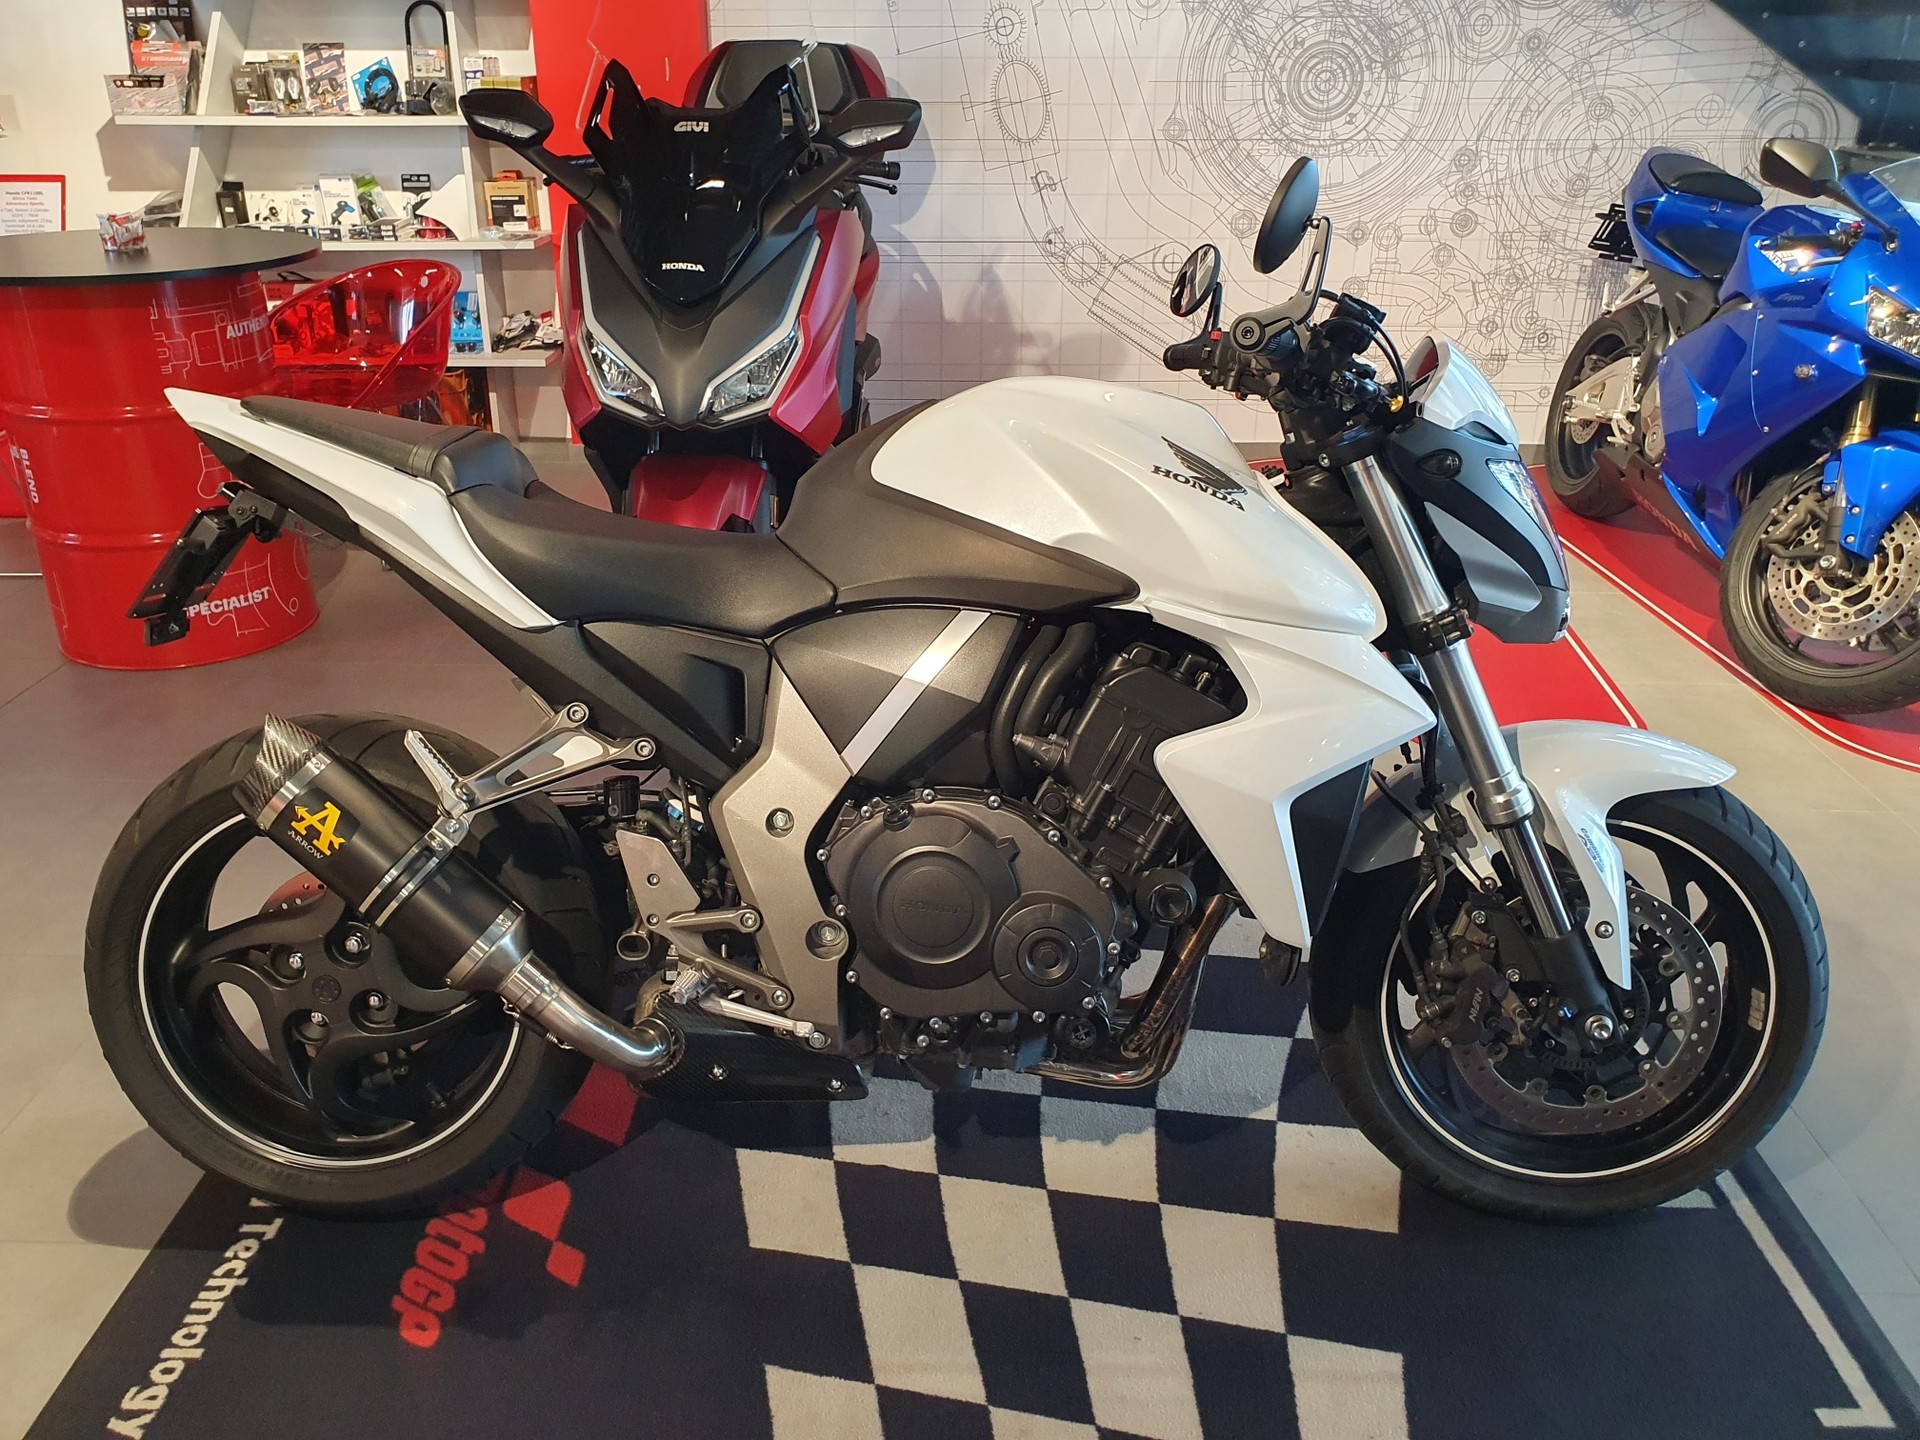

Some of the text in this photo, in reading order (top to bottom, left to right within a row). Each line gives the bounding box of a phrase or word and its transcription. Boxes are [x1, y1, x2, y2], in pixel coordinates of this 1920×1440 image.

[673, 121, 709, 132] GIVI
[661, 262, 706, 272] HONDA
[1150, 464, 1246, 512] HONDA
[287, 829, 324, 859] ARROW
[106, 1217, 284, 1440] Technology
